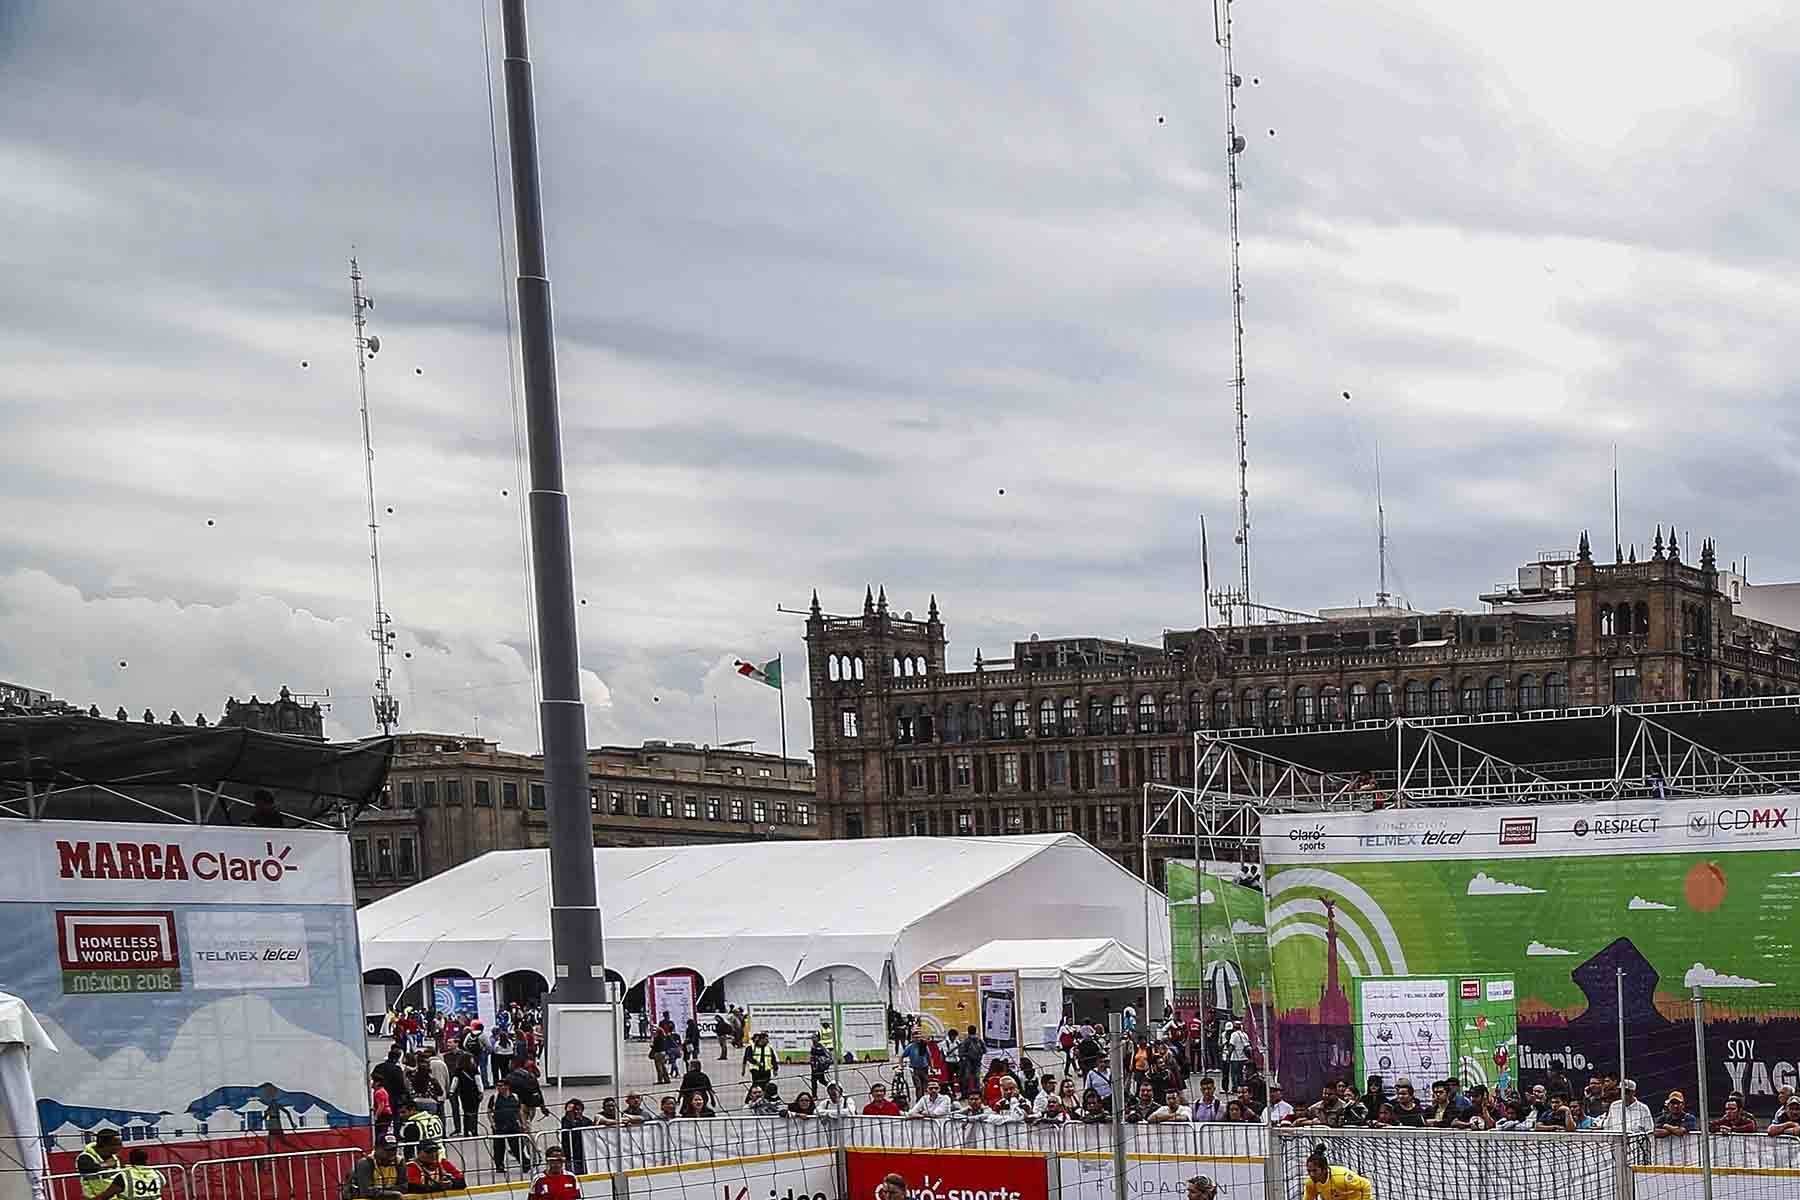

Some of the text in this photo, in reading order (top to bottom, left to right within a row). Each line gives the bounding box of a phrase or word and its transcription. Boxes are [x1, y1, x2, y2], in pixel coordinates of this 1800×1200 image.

[1594, 818, 1659, 834] RESPECT
[1717, 808, 1788, 830] CDMX
[1358, 830, 1465, 847] TELMEX telcel
[1299, 842, 1326, 852] sports
[56, 841, 288, 881] MARCA Claro
[80, 937, 157, 948] HOMELESS
[81, 951, 159, 962] WORLD CUP
[196, 948, 301, 961] TELMEX telcel
[136, 974, 172, 991] 2018
[1370, 1011, 1442, 1020] Programas Deportivos
[1728, 1039, 1755, 1059] SOY
[426, 1121, 442, 1137] 50
[135, 1180, 159, 1196] 94
[1096, 1181, 1228, 1194] FUNDACN
